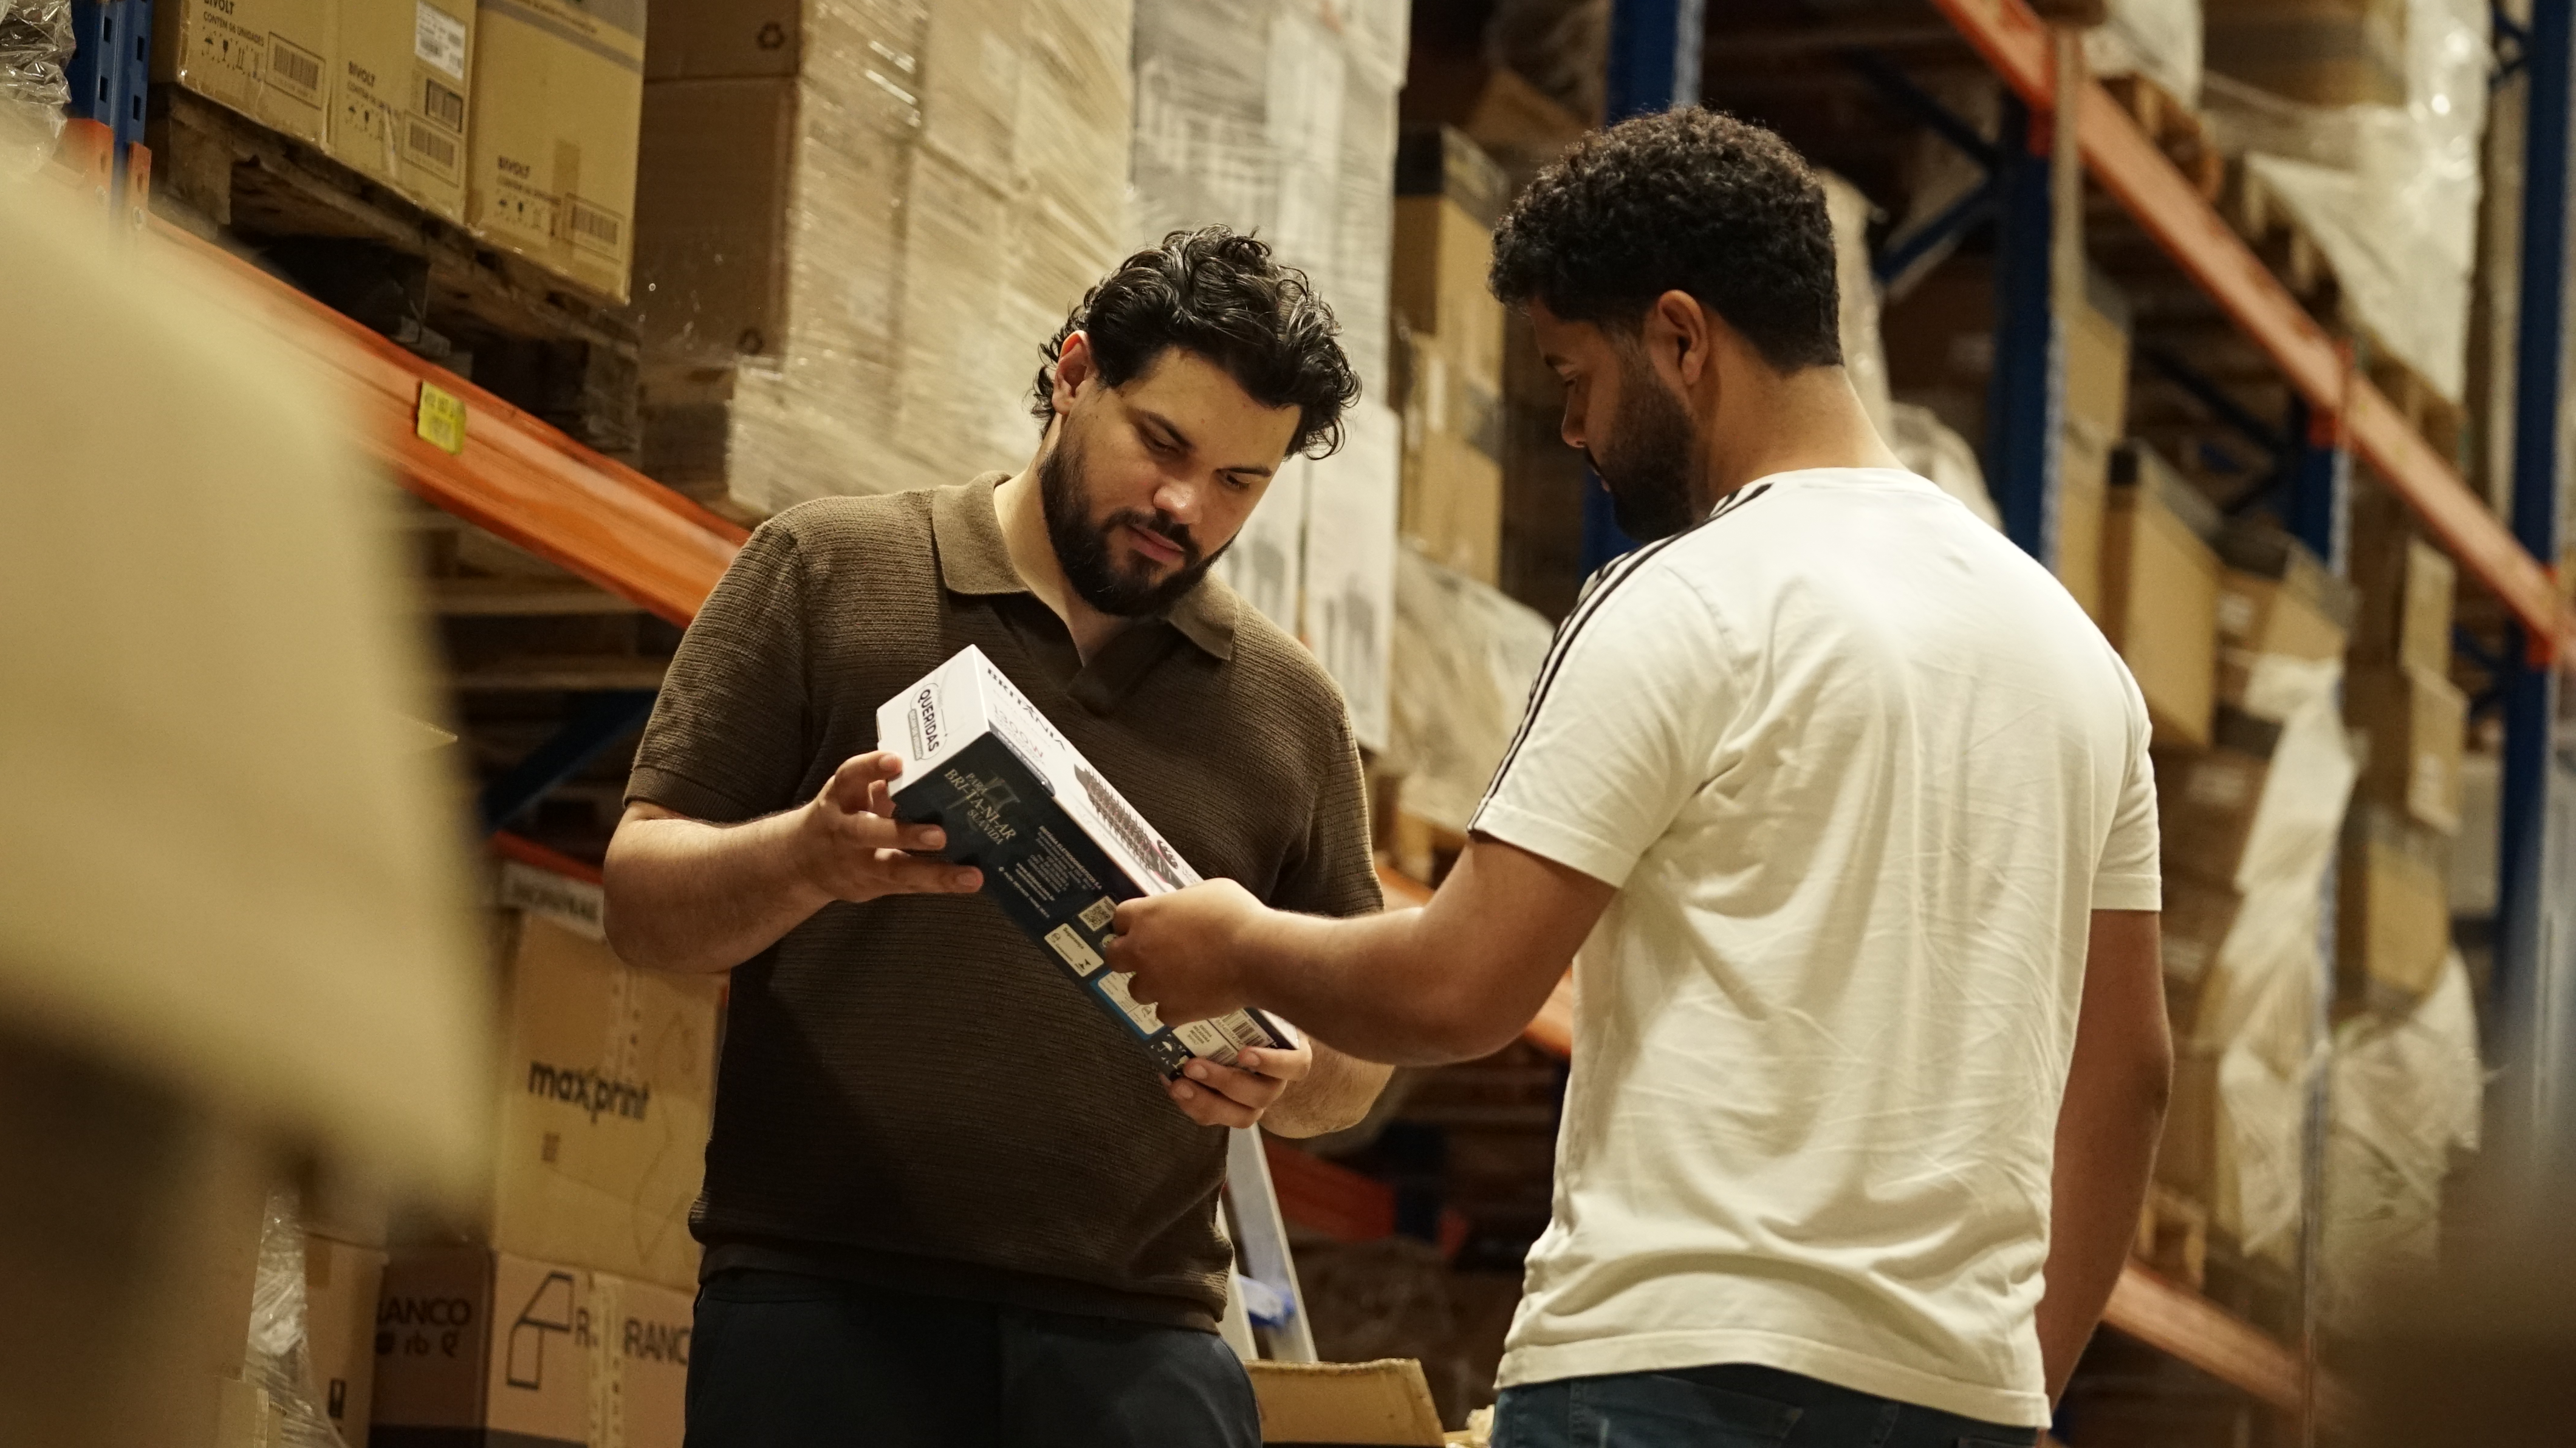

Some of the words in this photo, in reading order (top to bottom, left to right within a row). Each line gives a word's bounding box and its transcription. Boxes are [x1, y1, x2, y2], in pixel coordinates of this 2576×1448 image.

[348, 61, 375, 87] BIVOLT
[498, 155, 530, 179] BIVOLT
[917, 688, 939, 752] QUERIDAS
[987, 668, 1066, 751] BRITÂNIA
[965, 773, 988, 796] PARA
[967, 809, 985, 827] SUA
[984, 822, 1004, 845] VIDA
[528, 1061, 649, 1124] maxprint
